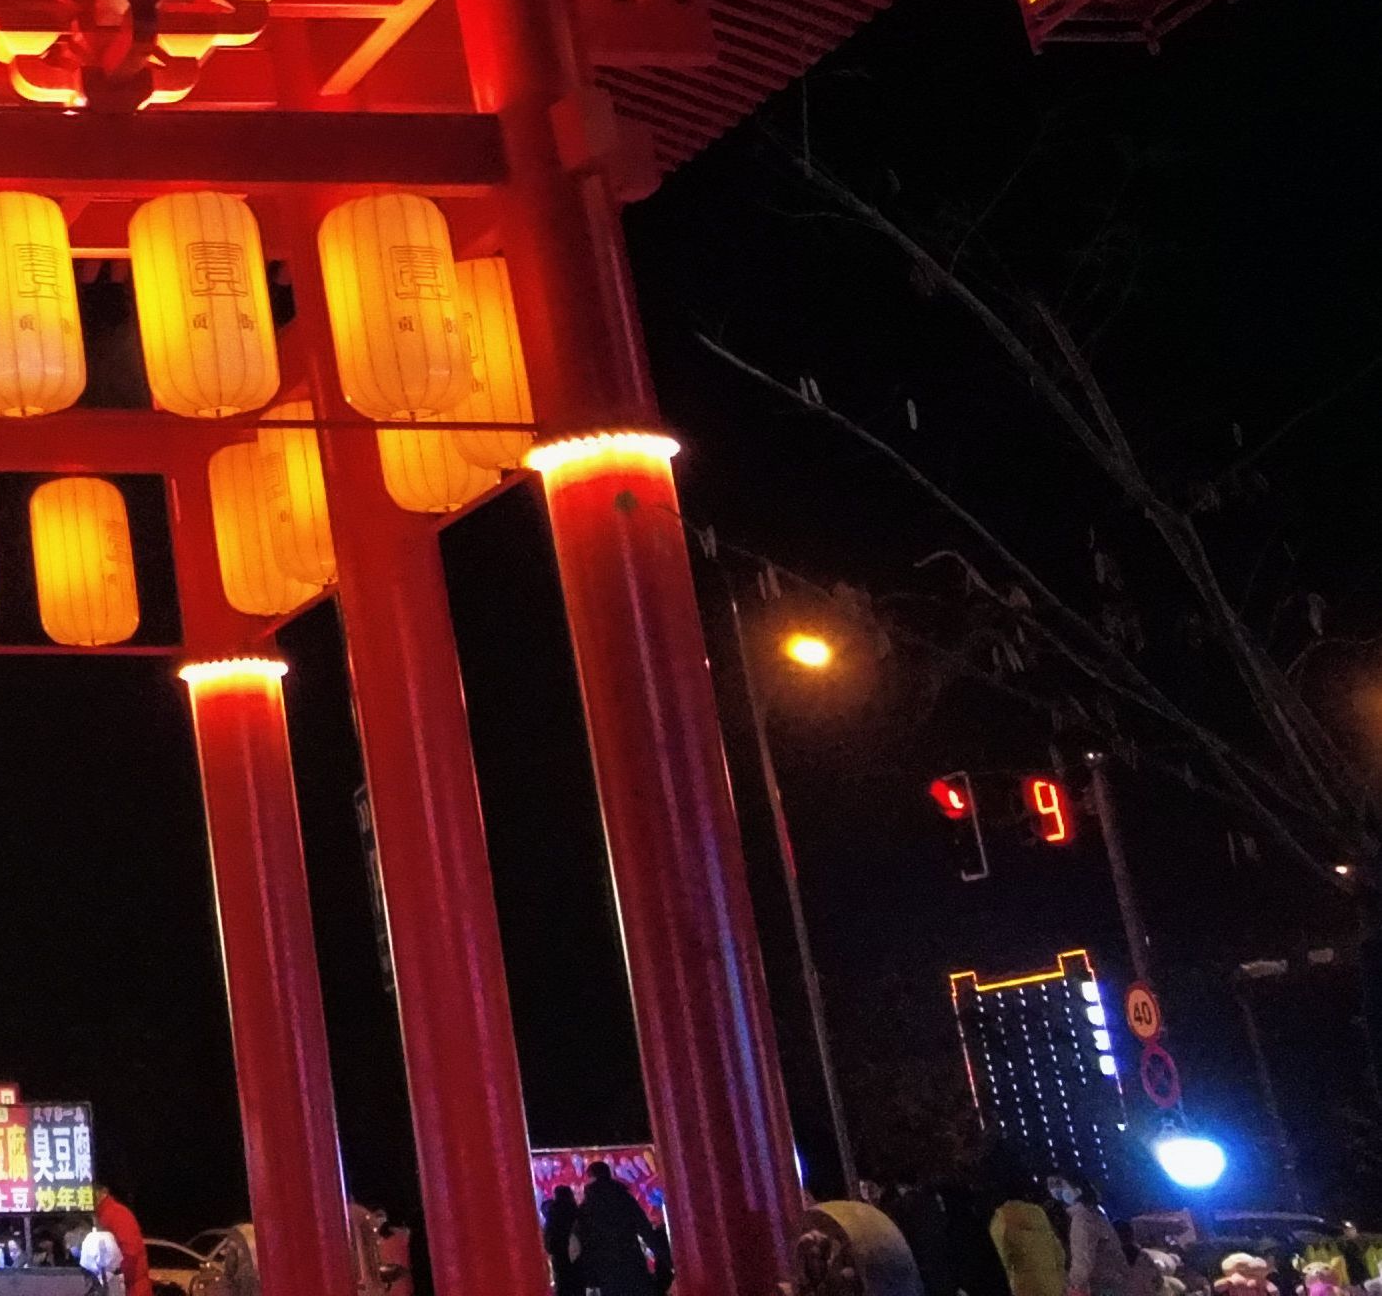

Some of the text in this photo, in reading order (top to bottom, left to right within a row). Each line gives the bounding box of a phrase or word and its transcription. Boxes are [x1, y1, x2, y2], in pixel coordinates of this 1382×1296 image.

[1032, 780, 1065, 842] 9
[1134, 1001, 1152, 1025] 40
[33, 1124, 92, 1183] 臭豆腐
[35, 1186, 95, 1212] 炒年糕
